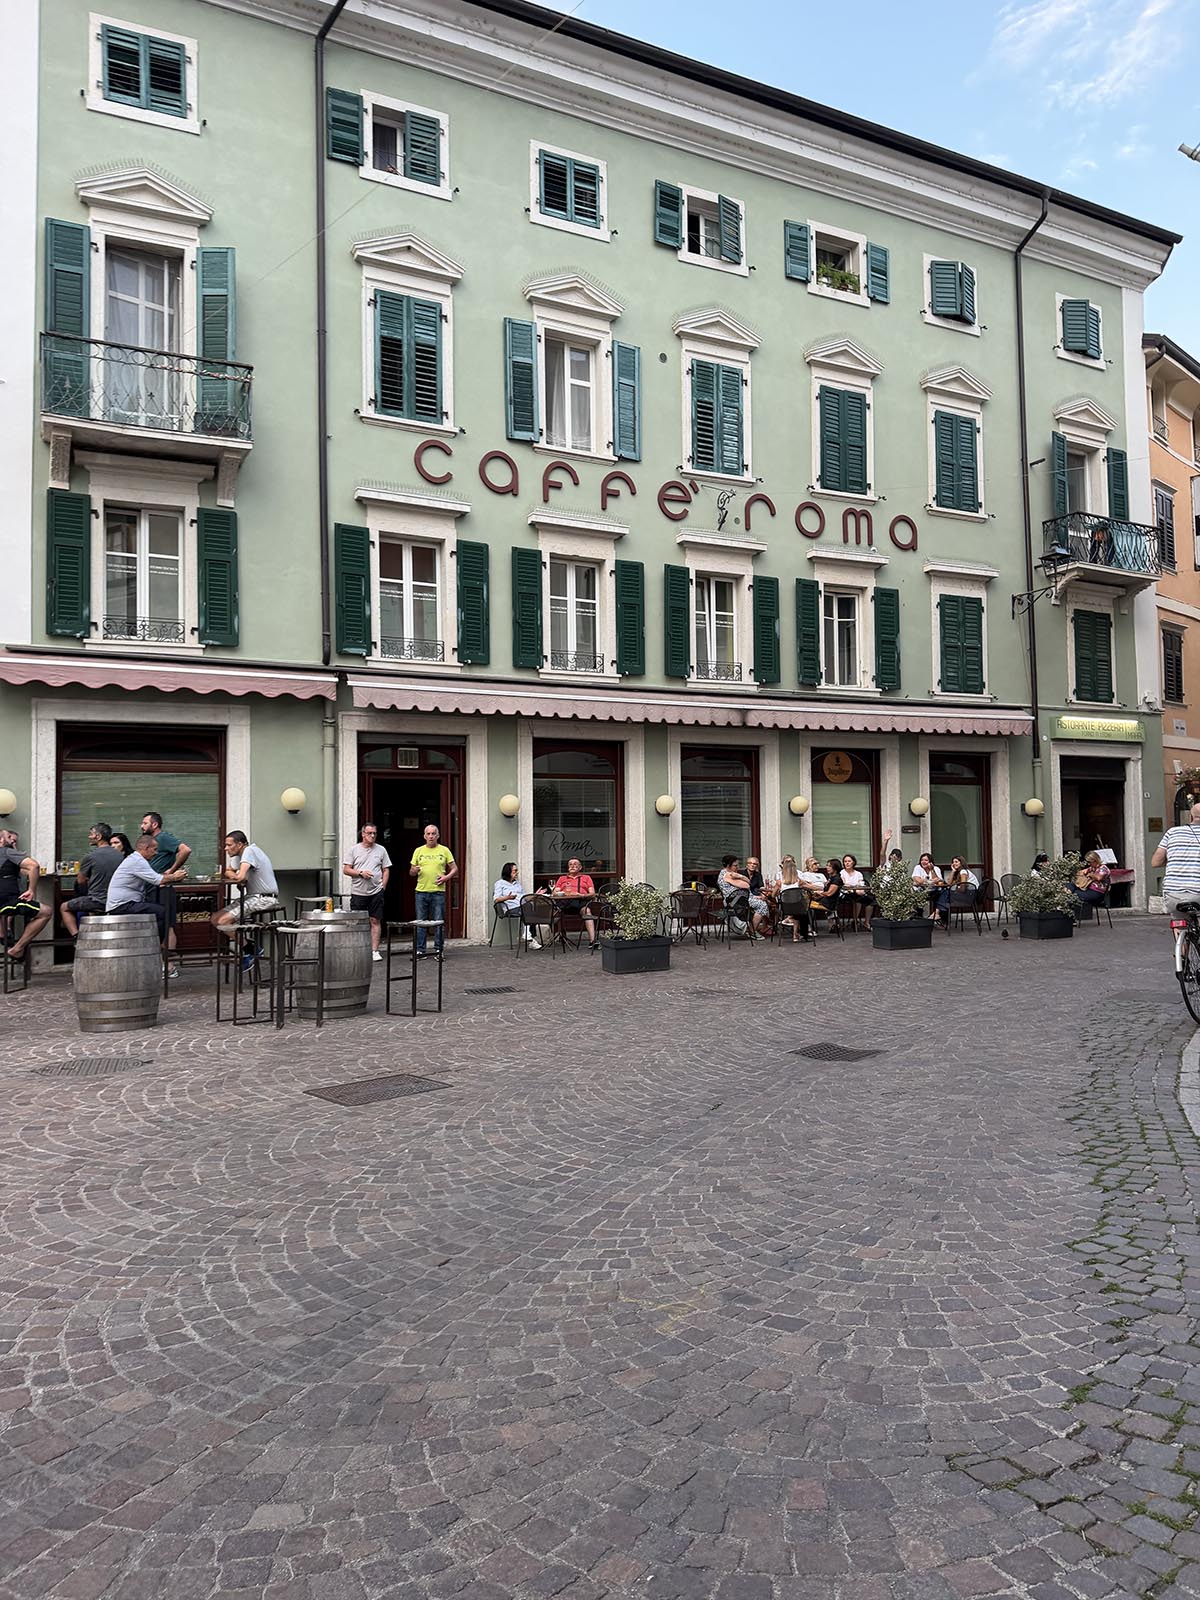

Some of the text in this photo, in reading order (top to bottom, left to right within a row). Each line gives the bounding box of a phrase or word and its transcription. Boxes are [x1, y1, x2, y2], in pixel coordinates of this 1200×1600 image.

[745, 493, 918, 551] roma
[1057, 719, 1095, 731] RISTORANTE
[542, 828, 595, 857] Roma
